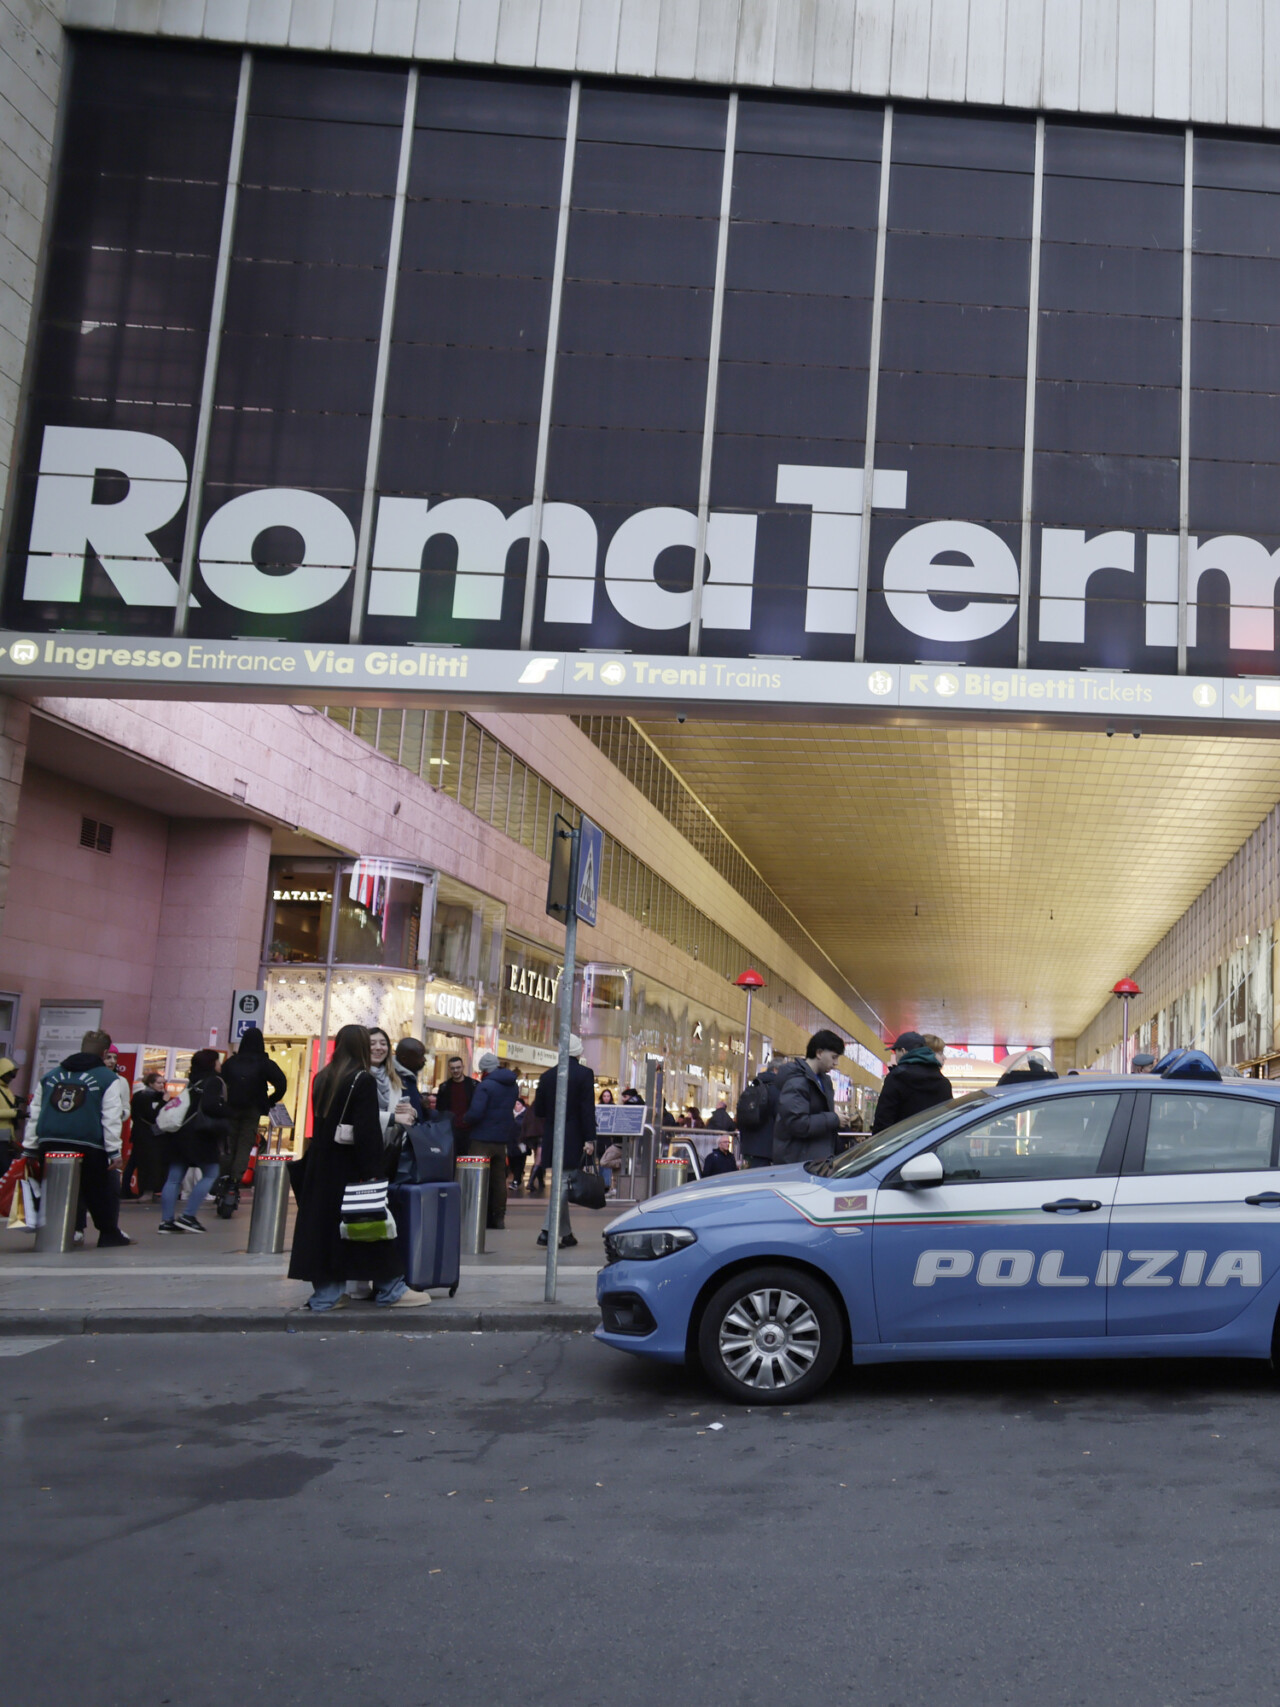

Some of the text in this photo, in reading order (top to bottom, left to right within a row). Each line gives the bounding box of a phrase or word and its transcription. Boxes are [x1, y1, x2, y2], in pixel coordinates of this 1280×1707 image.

[44, 640, 469, 678] Ingresso Entrance Via Giolitti
[632, 662, 781, 688] Treni Trains
[965, 674, 1153, 703] Biglietti Tickets
[273, 890, 327, 901] EATALY
[510, 964, 559, 1005] EATALY
[436, 992, 476, 1023] GUESS
[46, 1071, 71, 1088] STAY
[912, 1249, 1263, 1287] POLIZIA
